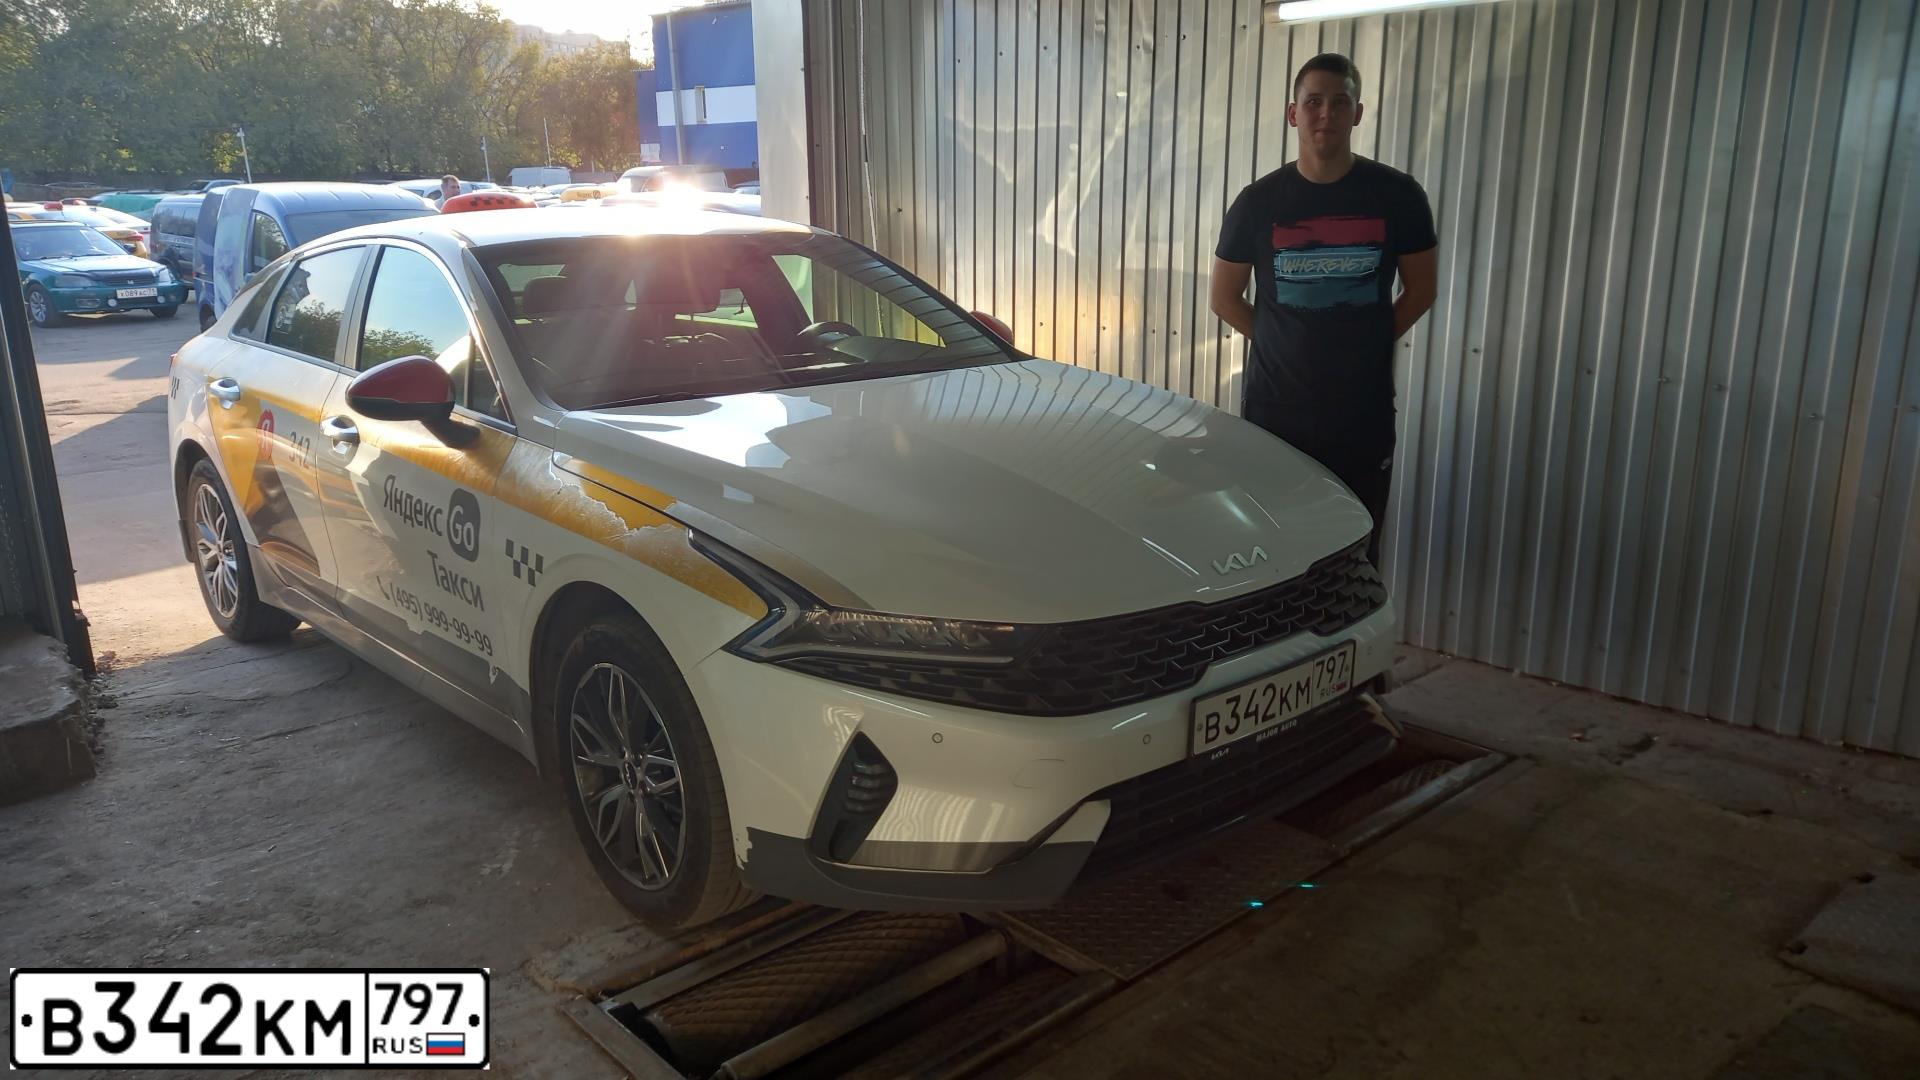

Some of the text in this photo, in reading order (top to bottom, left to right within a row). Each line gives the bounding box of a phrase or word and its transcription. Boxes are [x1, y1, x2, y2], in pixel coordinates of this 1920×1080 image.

[383, 474, 443, 537] Яндекс
[450, 504, 475, 552] Go
[427, 549, 485, 612] Такси
[389, 582, 493, 657] (495) 999-99-99
[1315, 650, 1348, 689] 797
